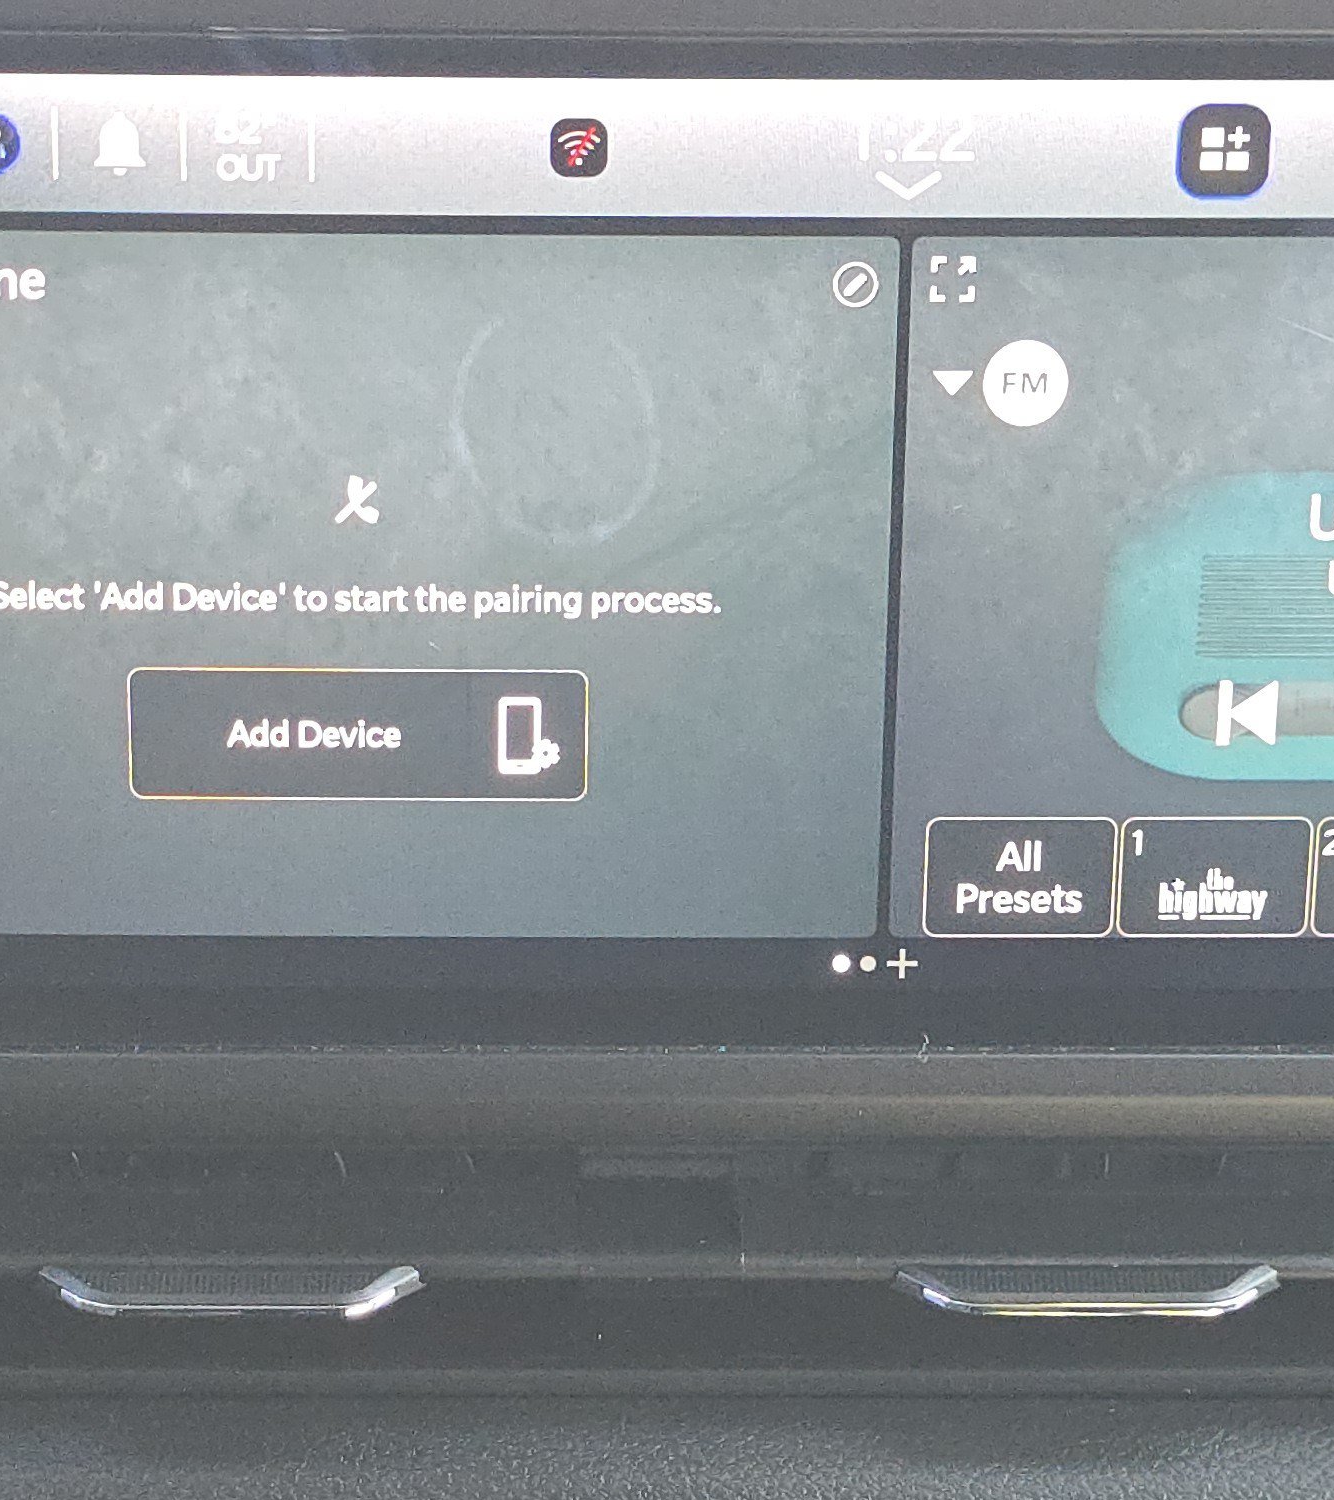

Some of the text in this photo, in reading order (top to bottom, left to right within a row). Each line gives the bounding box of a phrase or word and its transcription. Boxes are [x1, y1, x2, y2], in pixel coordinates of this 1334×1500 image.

[216, 152, 283, 183] OUT
[1001, 371, 1049, 394] FM
[93, 581, 164, 612] 'Add
[171, 582, 287, 614] Device'
[293, 585, 328, 614] to
[334, 584, 409, 614] start
[415, 584, 466, 614] the
[473, 585, 584, 620] pairing
[591, 588, 723, 620] process.
[227, 718, 402, 750] Add Device
[995, 840, 1042, 872] All
[1132, 828, 1144, 856] 1
[955, 882, 1083, 914] Presets
[1157, 880, 1269, 920] highway
